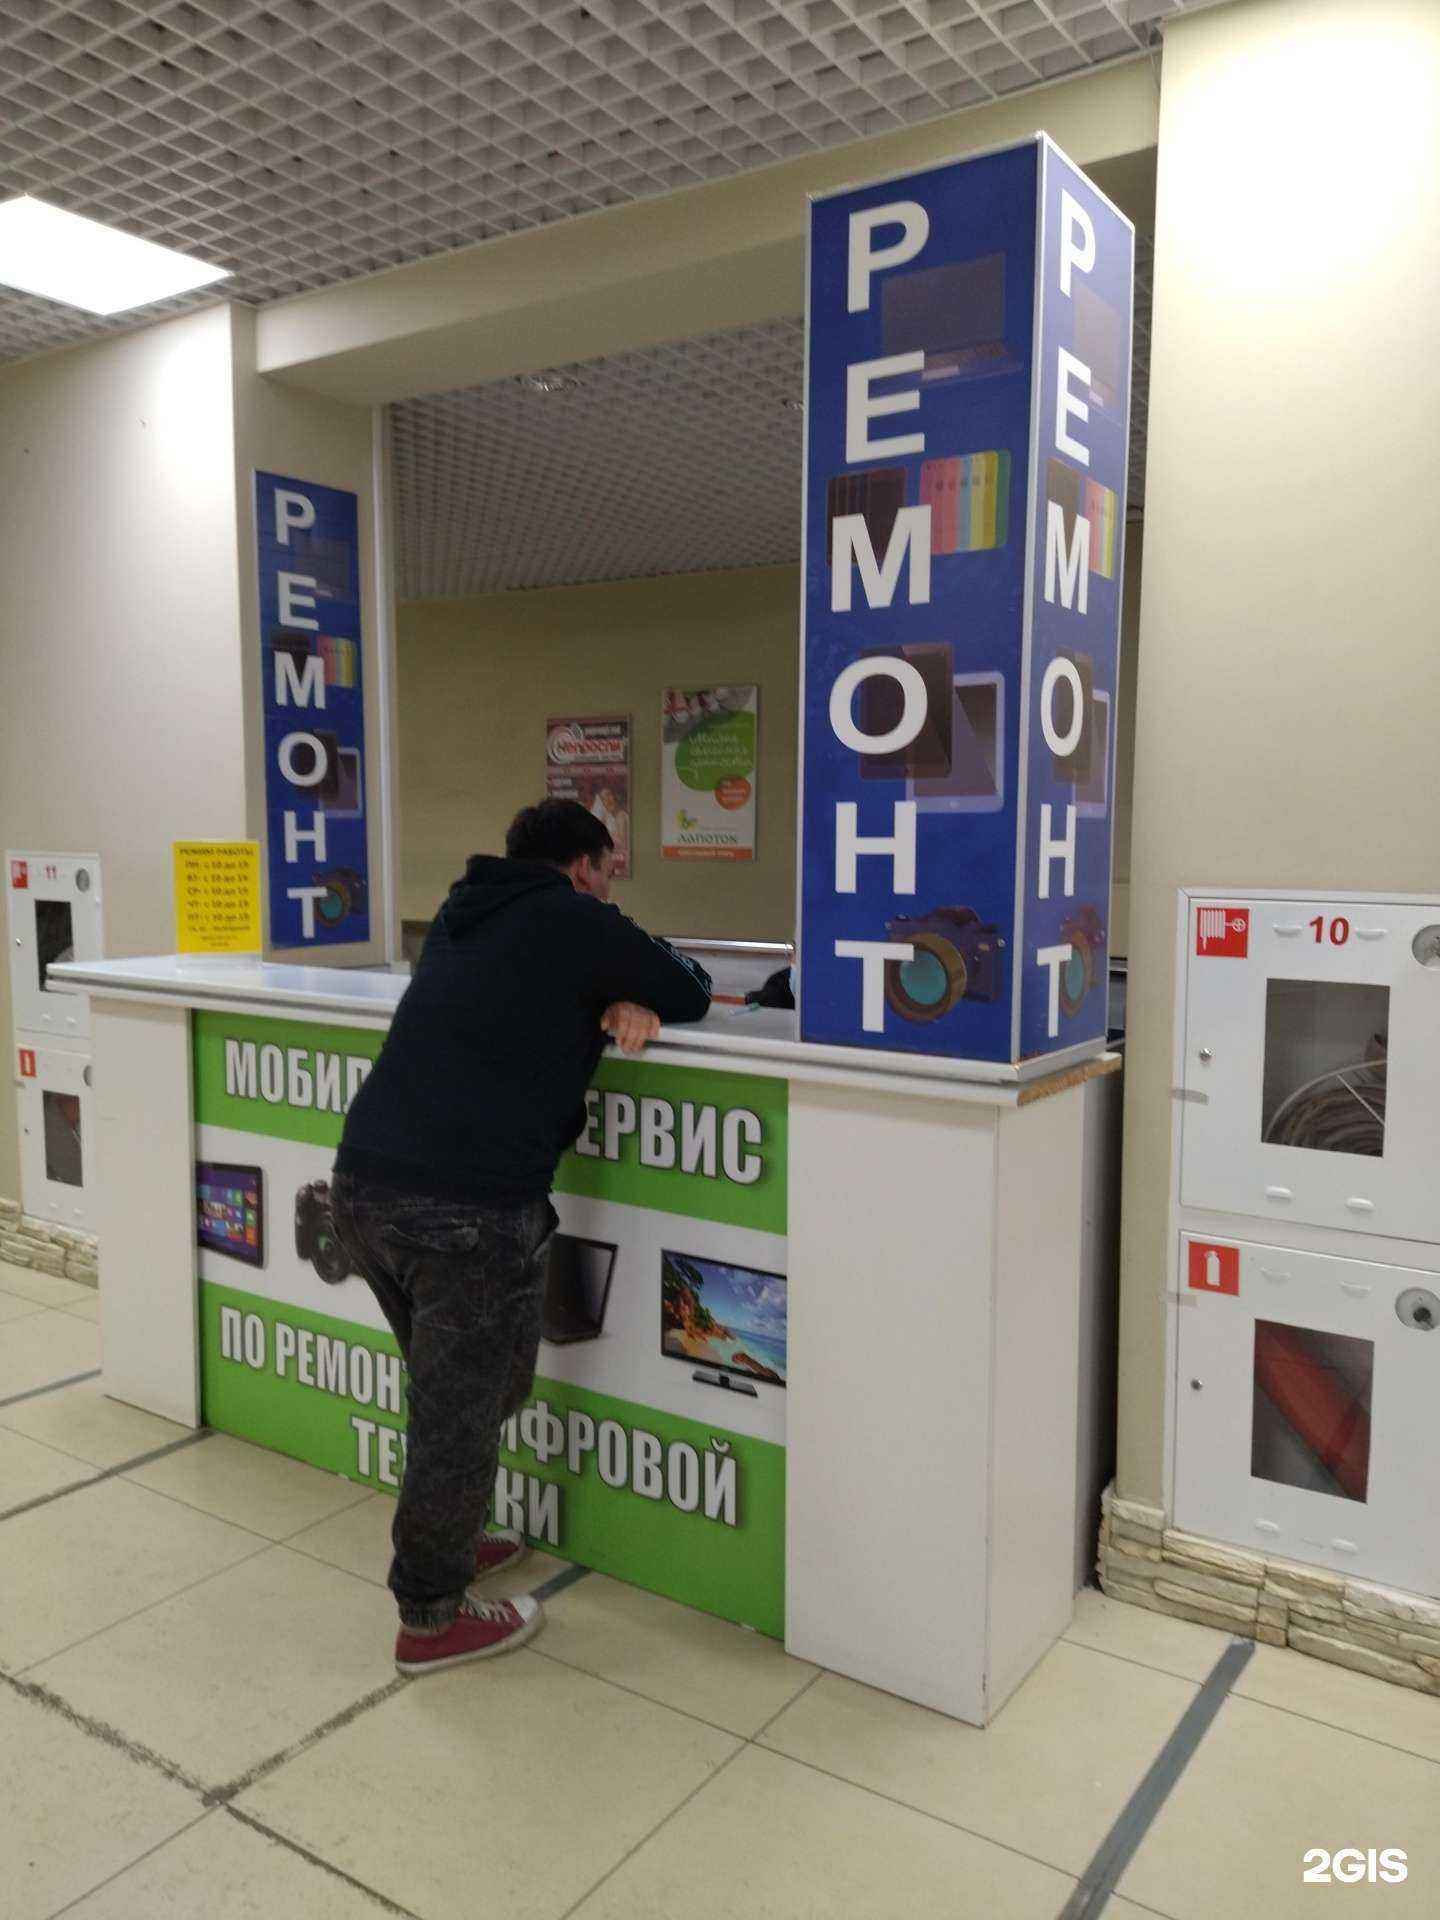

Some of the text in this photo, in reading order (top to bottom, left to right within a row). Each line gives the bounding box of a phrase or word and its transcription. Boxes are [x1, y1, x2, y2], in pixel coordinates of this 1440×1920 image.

[273, 488, 328, 939] РЕМОНТ
[829, 201, 932, 1033] РЕМОНТ
[1037, 188, 1096, 1037] РЕМОНТ
[1309, 916, 1350, 946] 10
[224, 1038, 763, 1185] МОБИЛ ЕРВИС
[221, 1305, 266, 1370] ПО
[275, 1322, 408, 1414] РЕМОН
